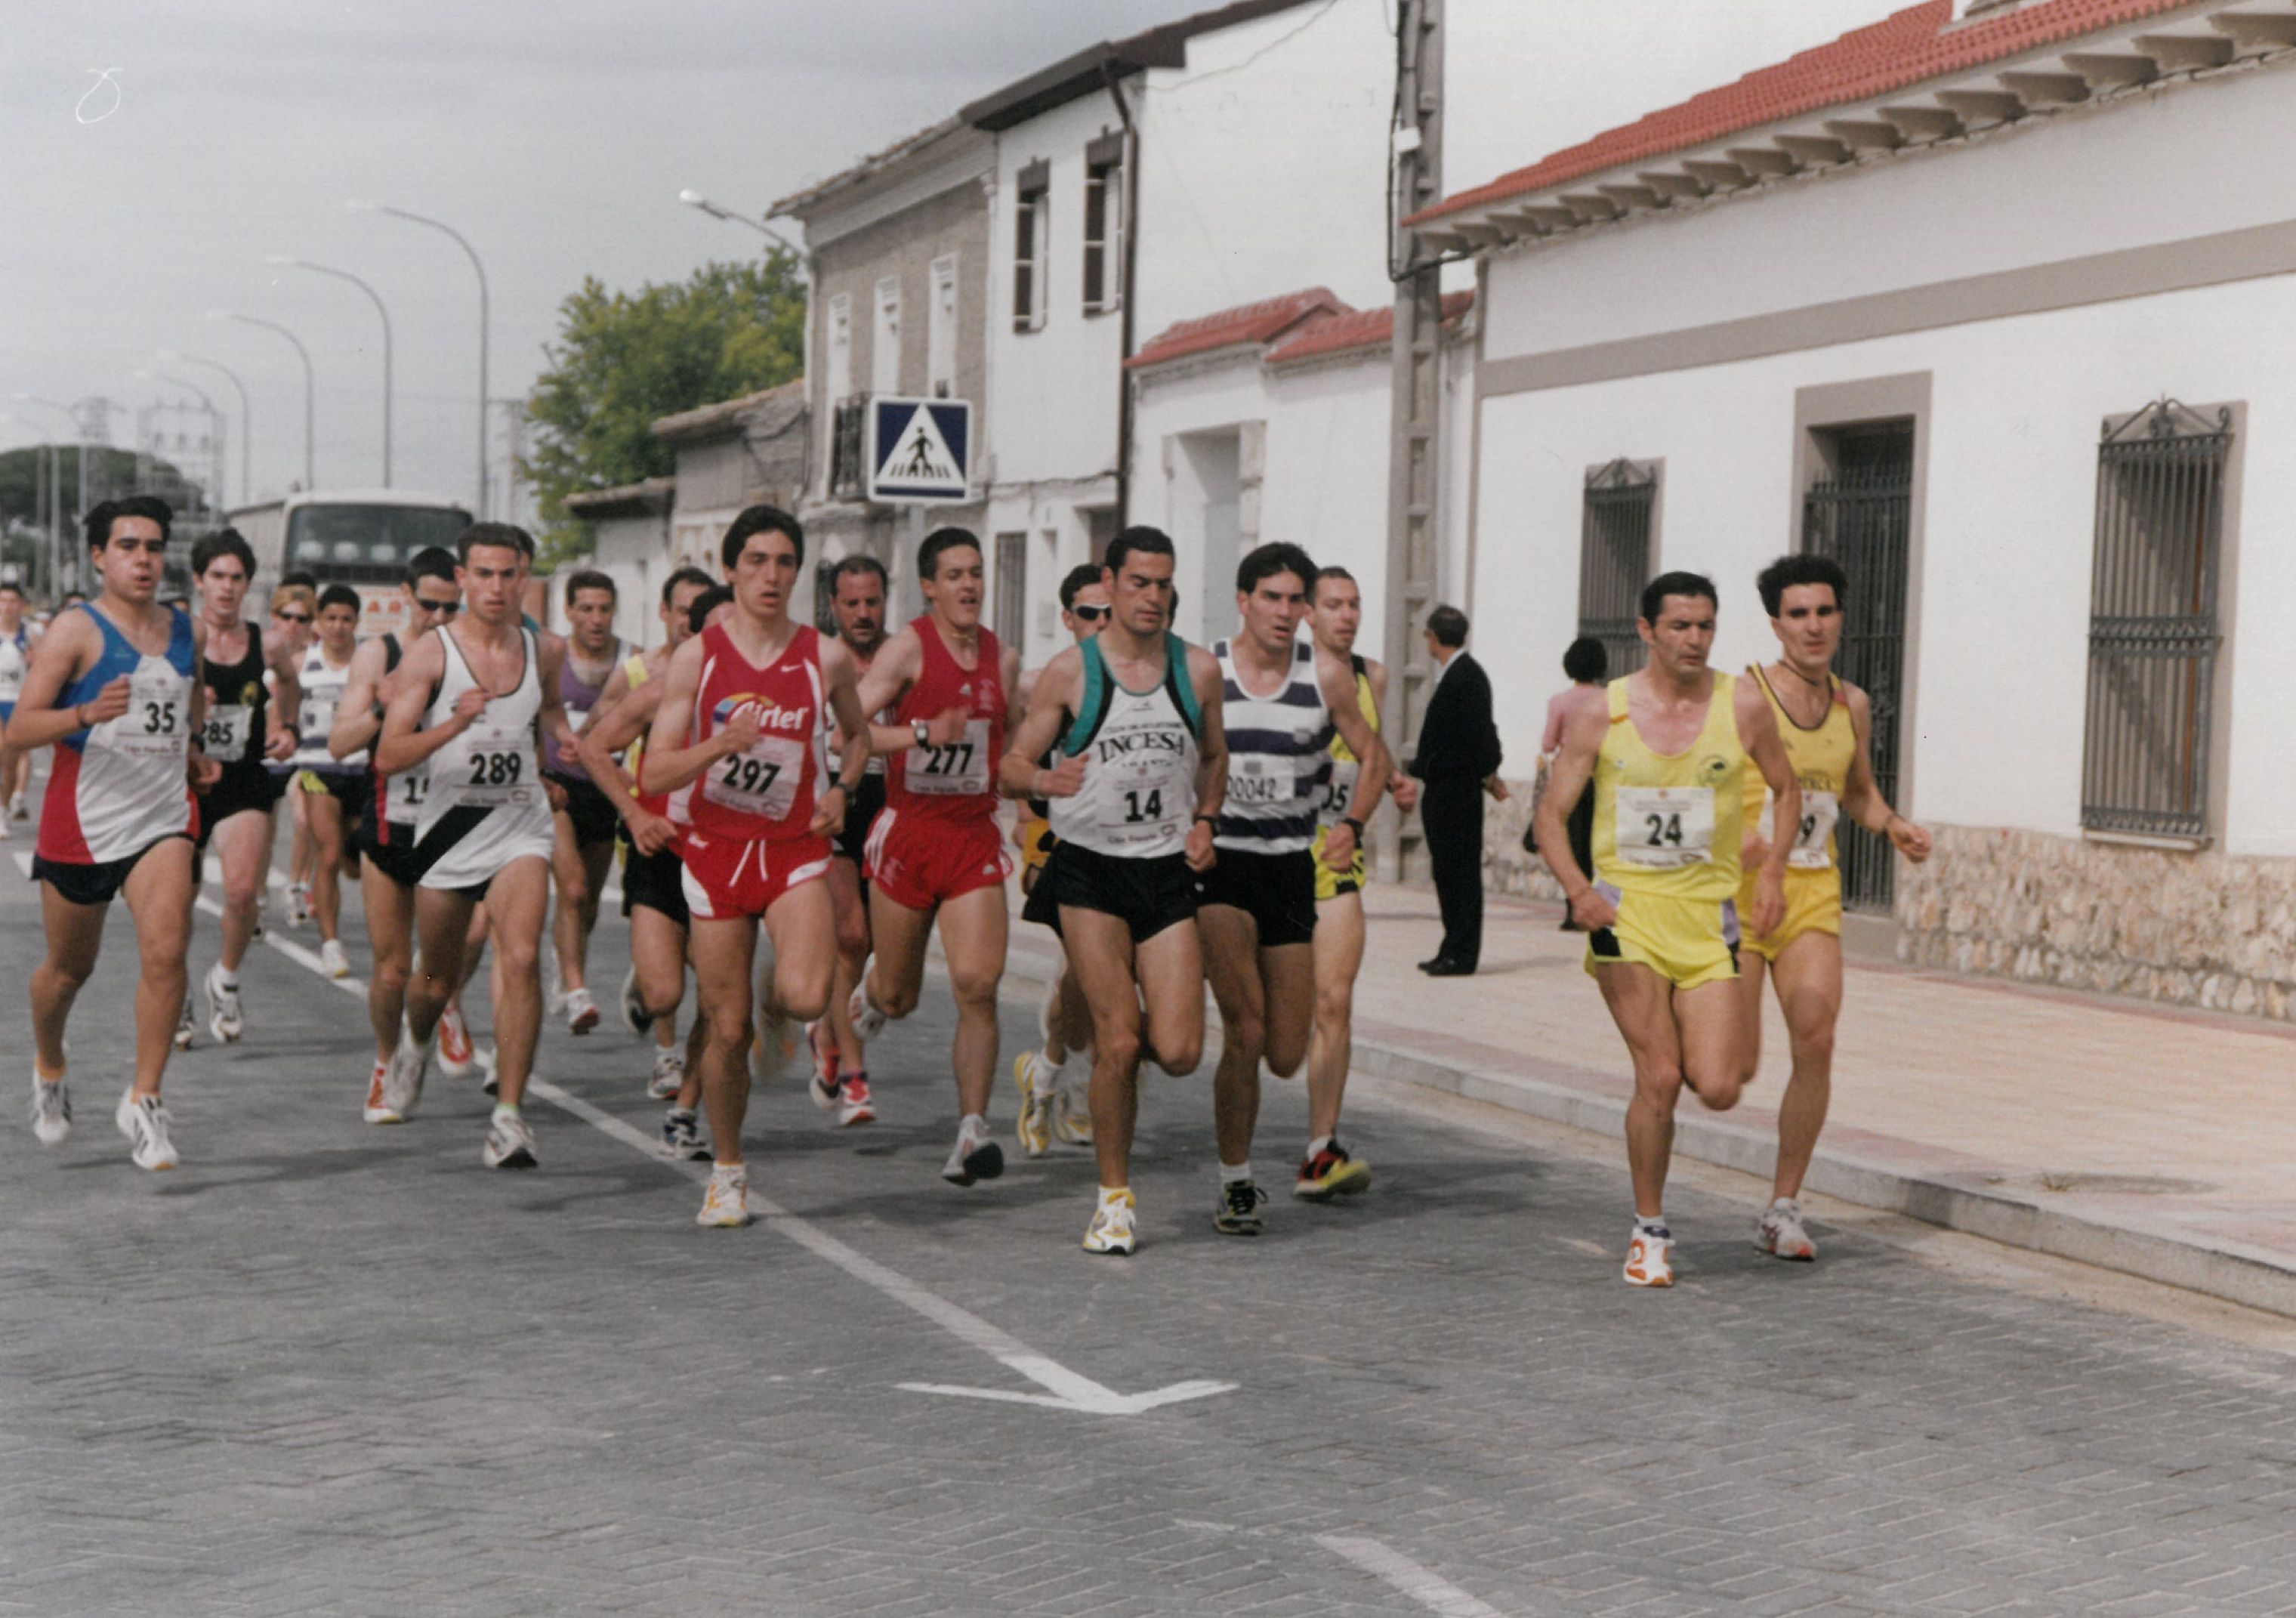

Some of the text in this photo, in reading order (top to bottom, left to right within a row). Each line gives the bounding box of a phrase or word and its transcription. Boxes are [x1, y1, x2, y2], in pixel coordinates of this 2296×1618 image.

[144, 701, 175, 733] 35
[470, 752, 521, 785] 289
[723, 755, 781, 795] 297
[924, 744, 973, 774] 277
[1125, 789, 1162, 823] 14
[1646, 814, 1683, 846] 24
